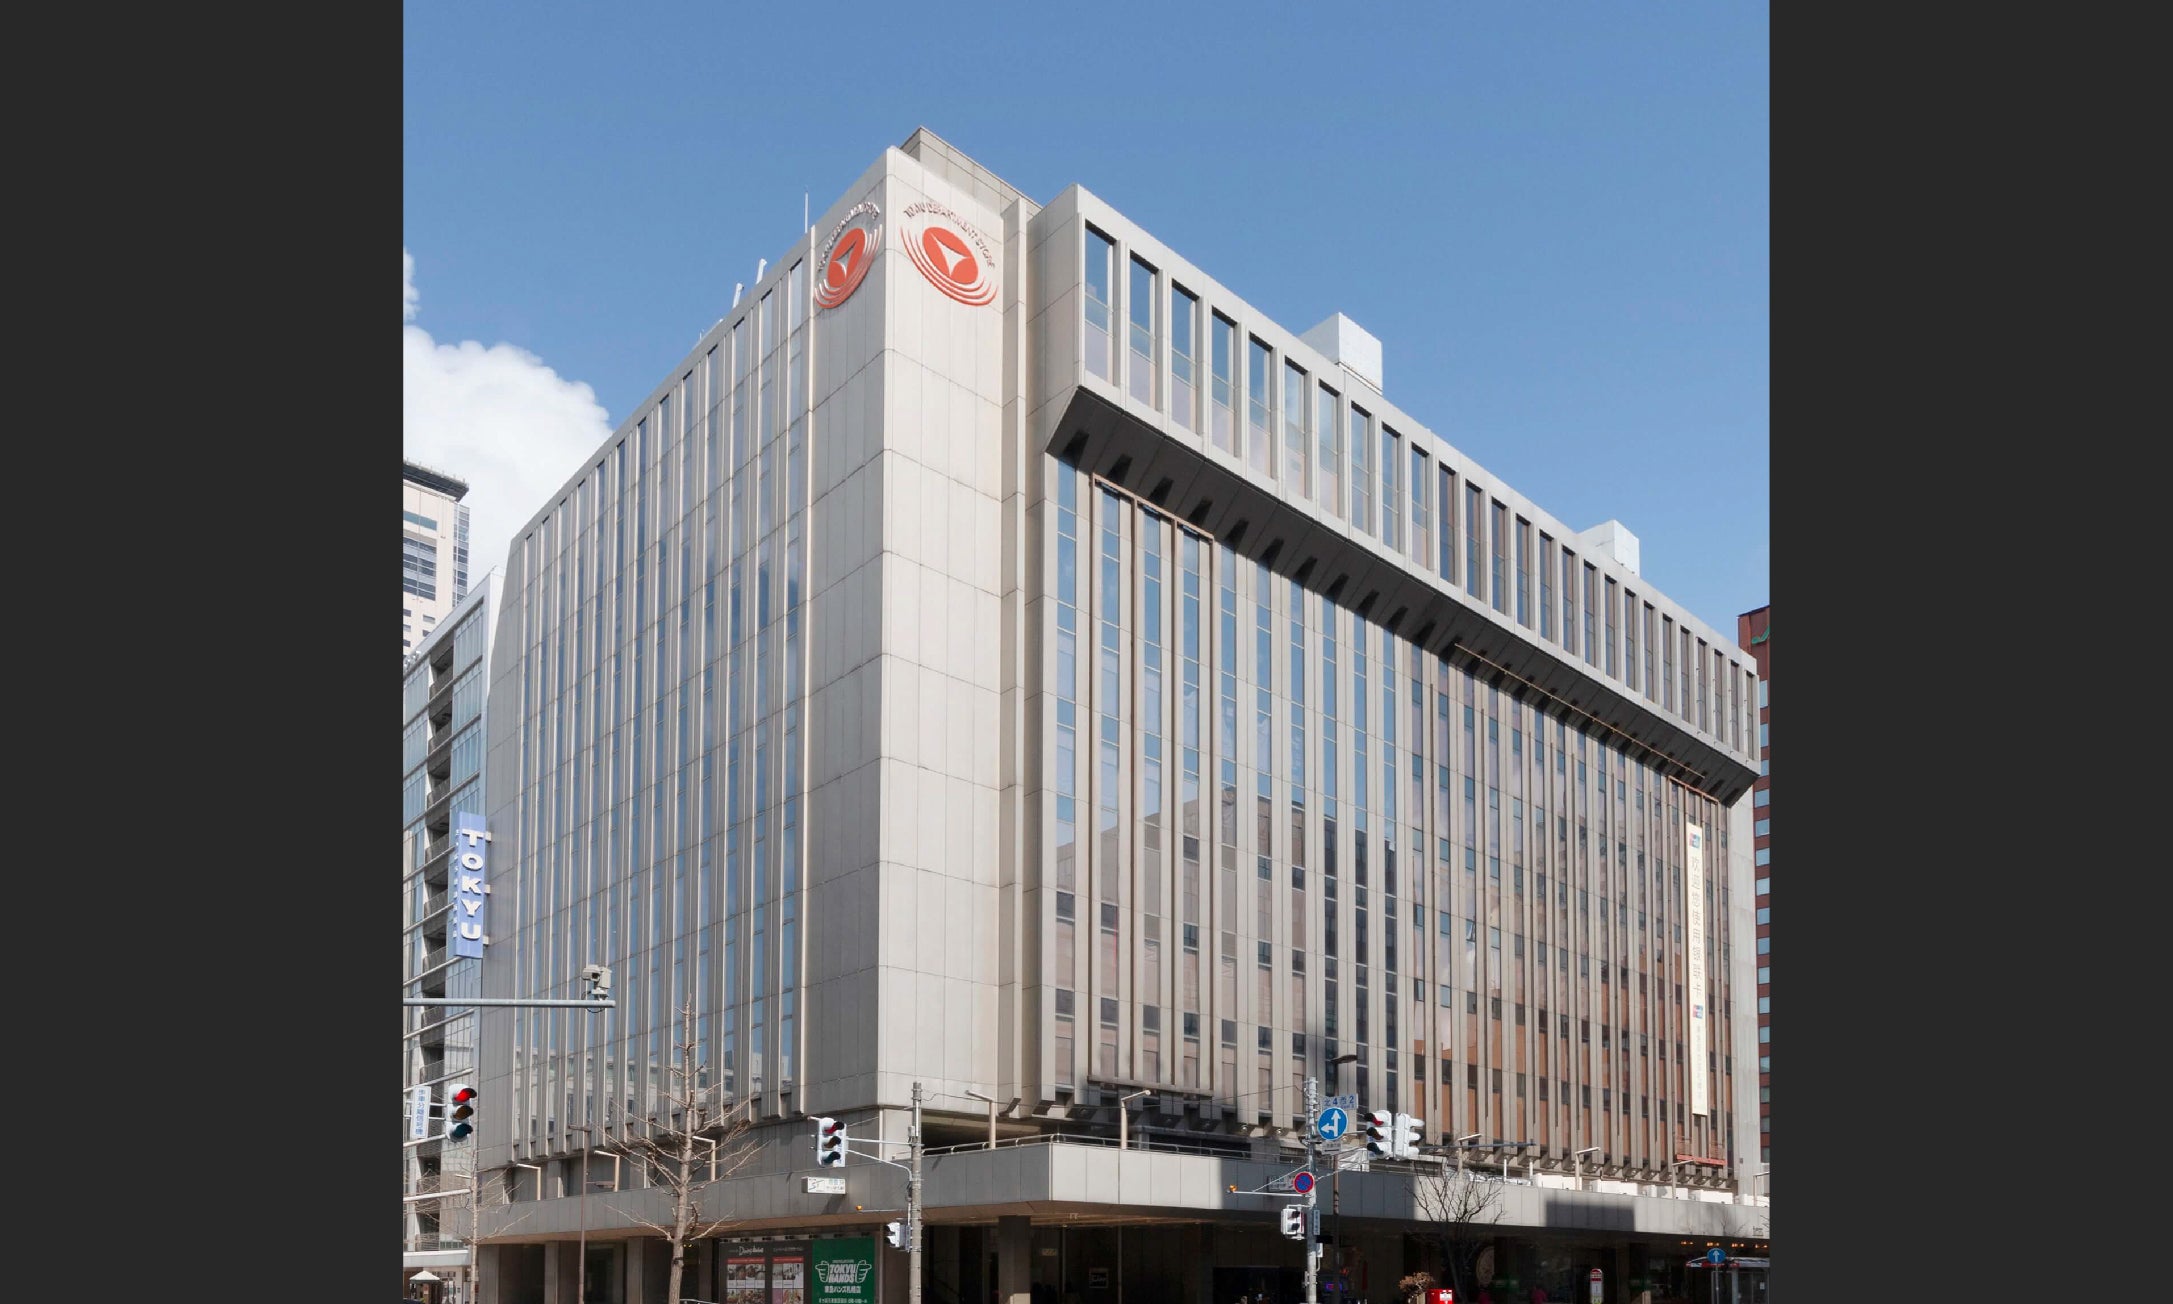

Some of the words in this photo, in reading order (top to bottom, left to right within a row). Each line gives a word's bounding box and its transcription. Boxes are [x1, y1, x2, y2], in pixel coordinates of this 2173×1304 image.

[461, 828, 484, 940] TOKYU
[829, 1264, 857, 1274] TOKYU
[828, 1273, 855, 1283] HANDS
